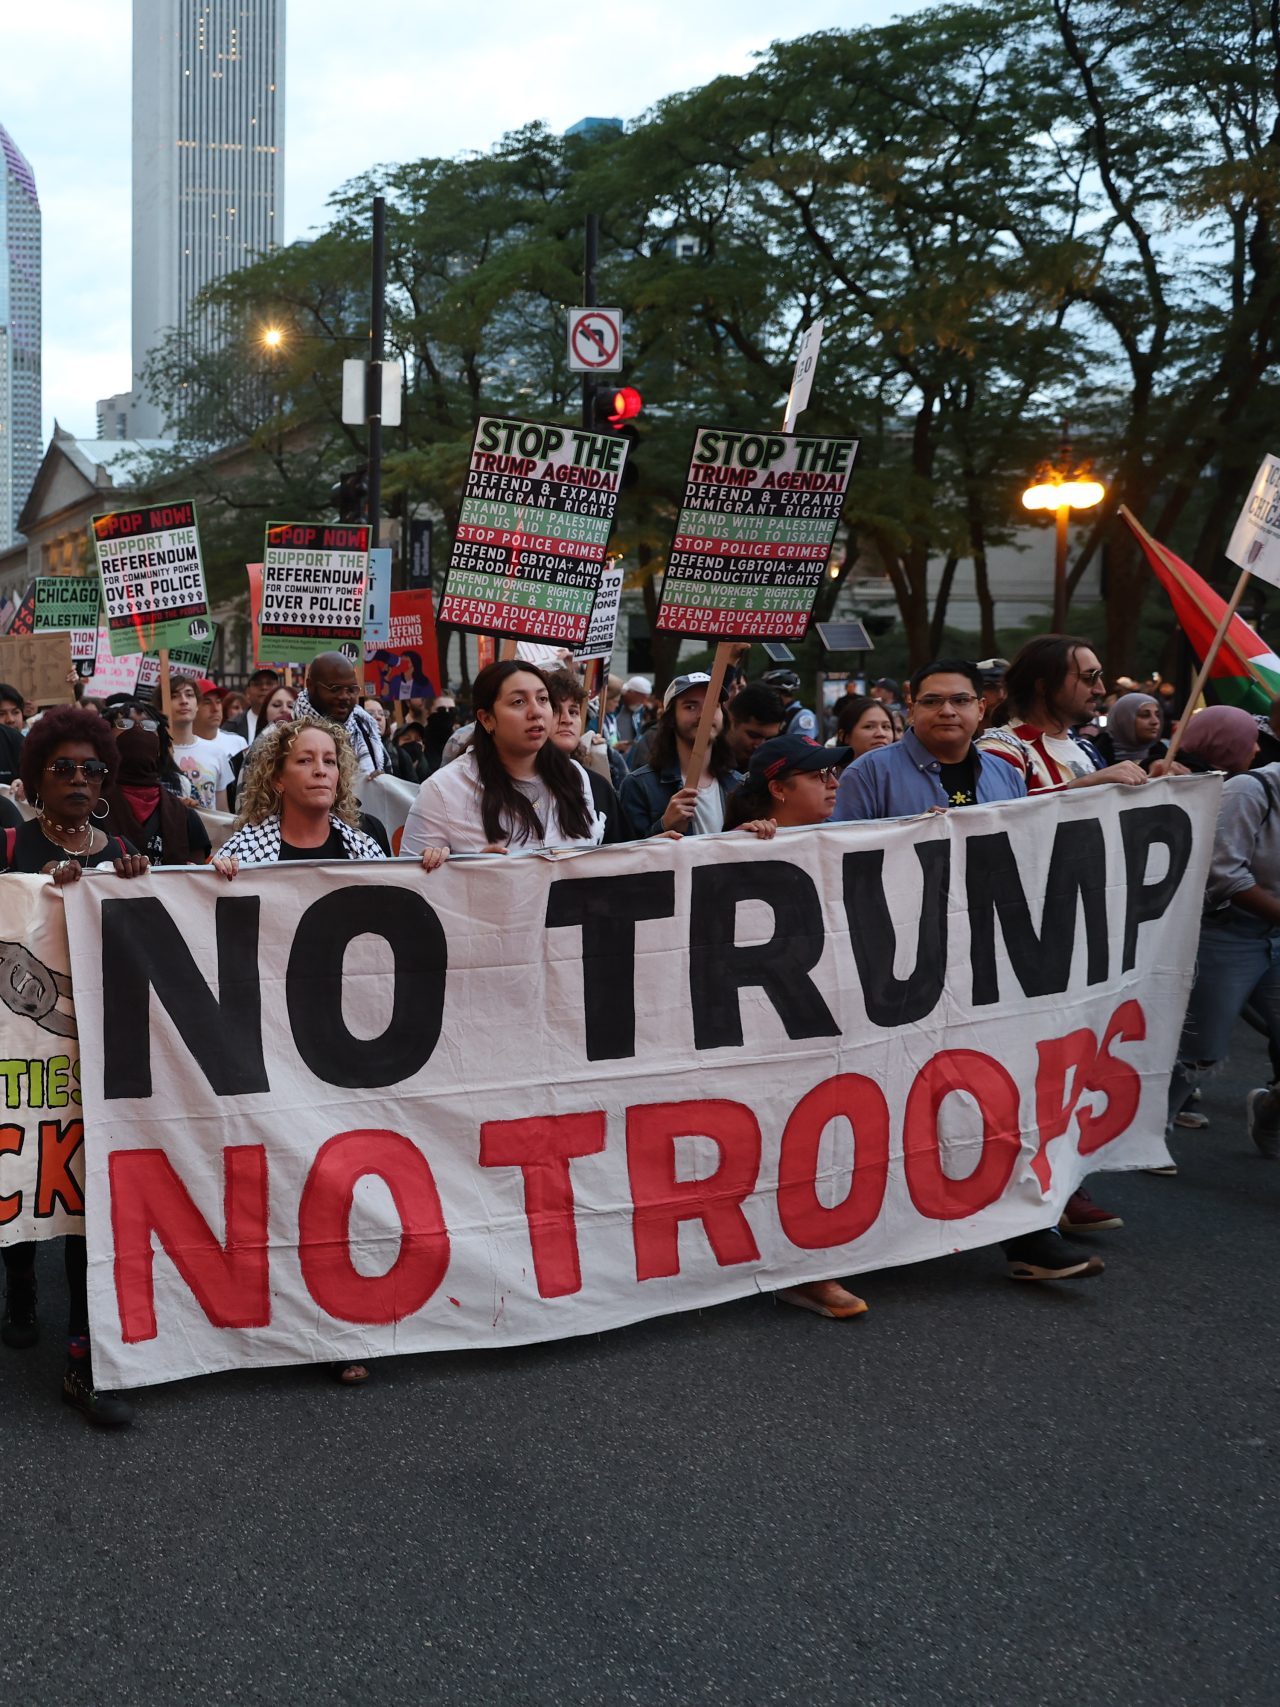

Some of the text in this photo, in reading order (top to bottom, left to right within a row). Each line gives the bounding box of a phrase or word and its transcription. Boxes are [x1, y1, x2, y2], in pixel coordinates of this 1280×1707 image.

[479, 420, 624, 472] STOP THE
[698, 432, 853, 474] STOP THE
[474, 452, 618, 490] TRUMP AGENDA!
[691, 463, 845, 492] TRUMP AGENDA!
[468, 471, 617, 506] DEFEND & EXPAND
[685, 484, 843, 506] DEFEND & EXPAND
[465, 484, 614, 518] IMMIGRANT RIGHTS
[682, 496, 840, 519] IMMIGRANT RIGHTS
[96, 504, 193, 537] CPOP NOW!
[464, 498, 609, 532] STAND WITH PALESTINE
[680, 511, 834, 532] STAND WITH PALESTINE
[269, 528, 316, 545] CPOP
[461, 511, 606, 544] END US AID TO ISRAEL
[677, 523, 830, 544] END US AID TO ISRAEL
[99, 530, 194, 557] SUPPORT THE
[457, 525, 604, 559] STOP POLICE CRIMES
[674, 537, 828, 559] STOP POLICE CRIMES
[102, 546, 197, 574] REFERENDUM
[268, 552, 365, 568] SUPPORT THE
[670, 553, 824, 574] DEFEND LGBTQIA+ AND
[104, 563, 199, 585] FOR COMMUNITY POWER
[267, 567, 363, 584] REFERENDUM
[667, 565, 821, 586] REPRODUCTIVE RIGHTS
[37, 588, 99, 603] CHICAGO
[106, 574, 201, 601] OVER POLICE
[266, 584, 363, 596] FOR COMMUNITY POWER
[665, 580, 708, 593] DEFEND
[763, 586, 800, 598] RIGHTS
[800, 587, 816, 598] TO
[89, 605, 97, 613] TO
[265, 595, 362, 612] OVER POLICE
[662, 592, 813, 612] UNIONIZE & STRIKE
[35, 614, 96, 627] PALESTINE
[659, 605, 808, 625] DEFEND EDUCATION &
[657, 617, 805, 636] ACADEMIC FREEDOM
[101, 801, 1194, 1100] NO TRUMP
[108, 998, 1146, 1345] NO TROOPS
